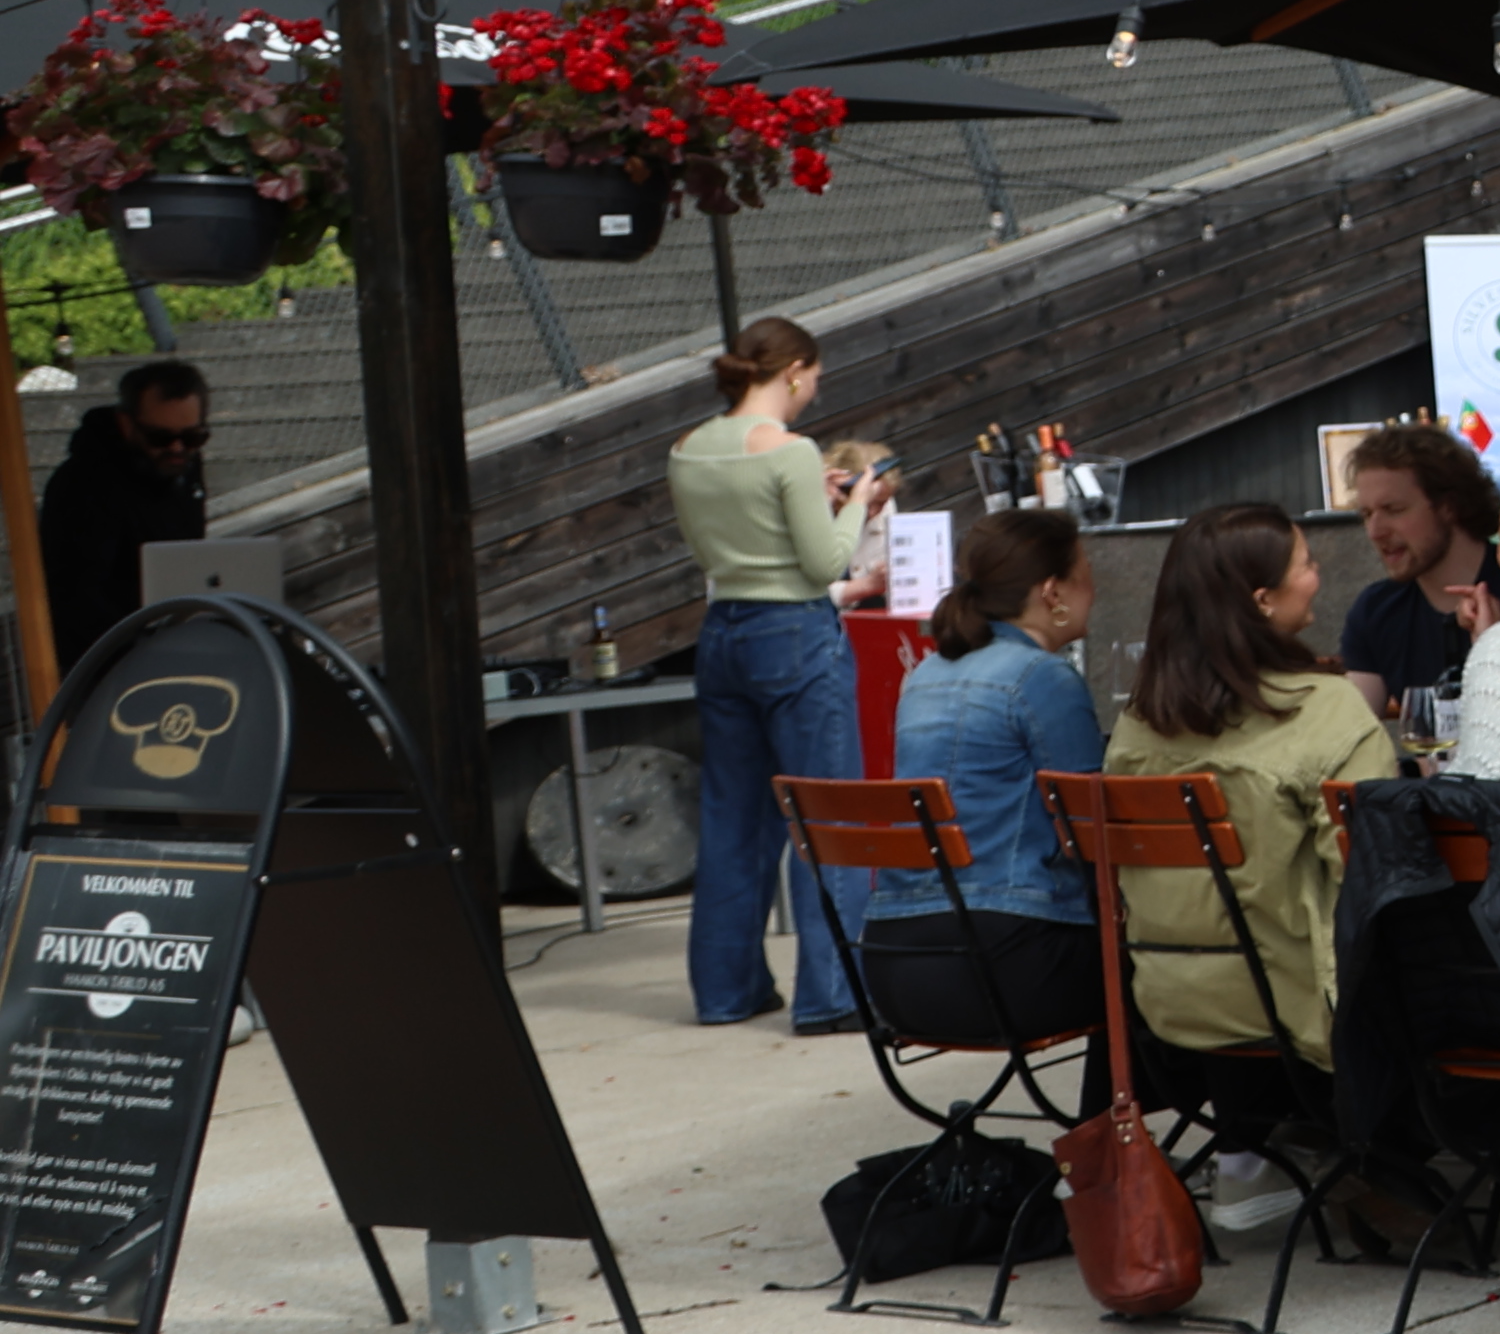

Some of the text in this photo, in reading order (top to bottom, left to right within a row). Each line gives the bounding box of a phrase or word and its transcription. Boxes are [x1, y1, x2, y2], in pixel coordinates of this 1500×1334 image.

[82, 874, 196, 899] VELKOMMEN TIL
[36, 934, 209, 972] PAVILJONGEN
